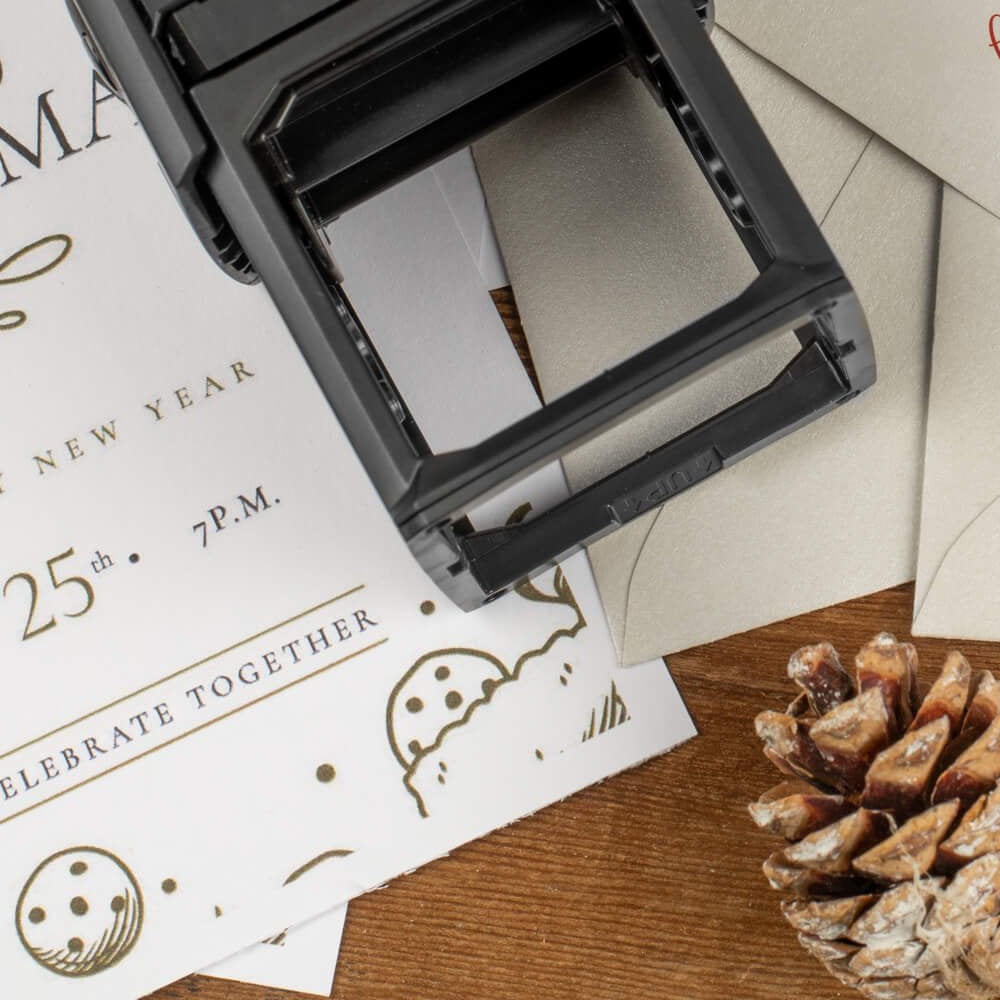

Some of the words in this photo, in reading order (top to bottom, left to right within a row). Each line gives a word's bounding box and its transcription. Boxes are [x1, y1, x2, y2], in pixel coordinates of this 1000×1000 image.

[32, 420, 118, 476] NEW
[144, 360, 255, 423] YEAR
[186, 608, 379, 711] TOGETHER
